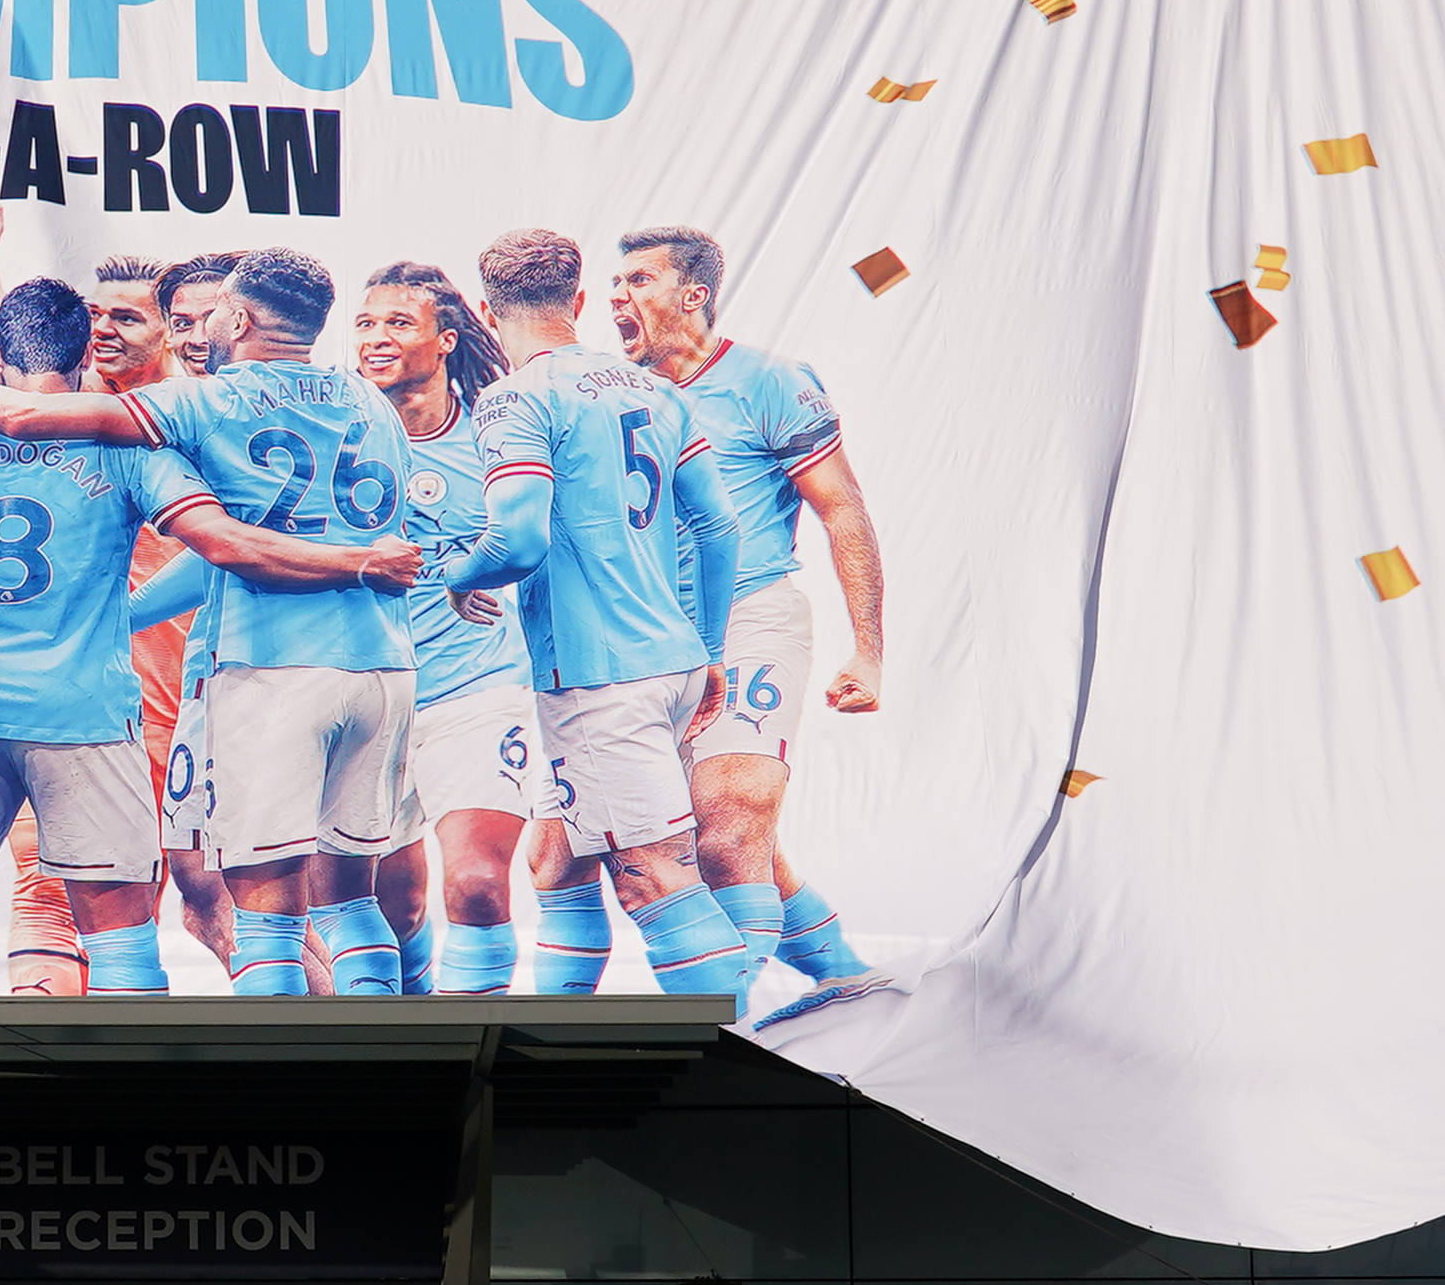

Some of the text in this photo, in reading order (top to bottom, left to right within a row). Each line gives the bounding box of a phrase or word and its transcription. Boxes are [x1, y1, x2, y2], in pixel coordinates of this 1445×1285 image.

[575, 368, 656, 401] STONES
[474, 406, 510, 429] TIRE
[246, 420, 399, 537] 26
[619, 407, 663, 532] 5
[724, 663, 783, 713] 16
[497, 725, 529, 771] 6
[143, 1144, 325, 1186] STAND
